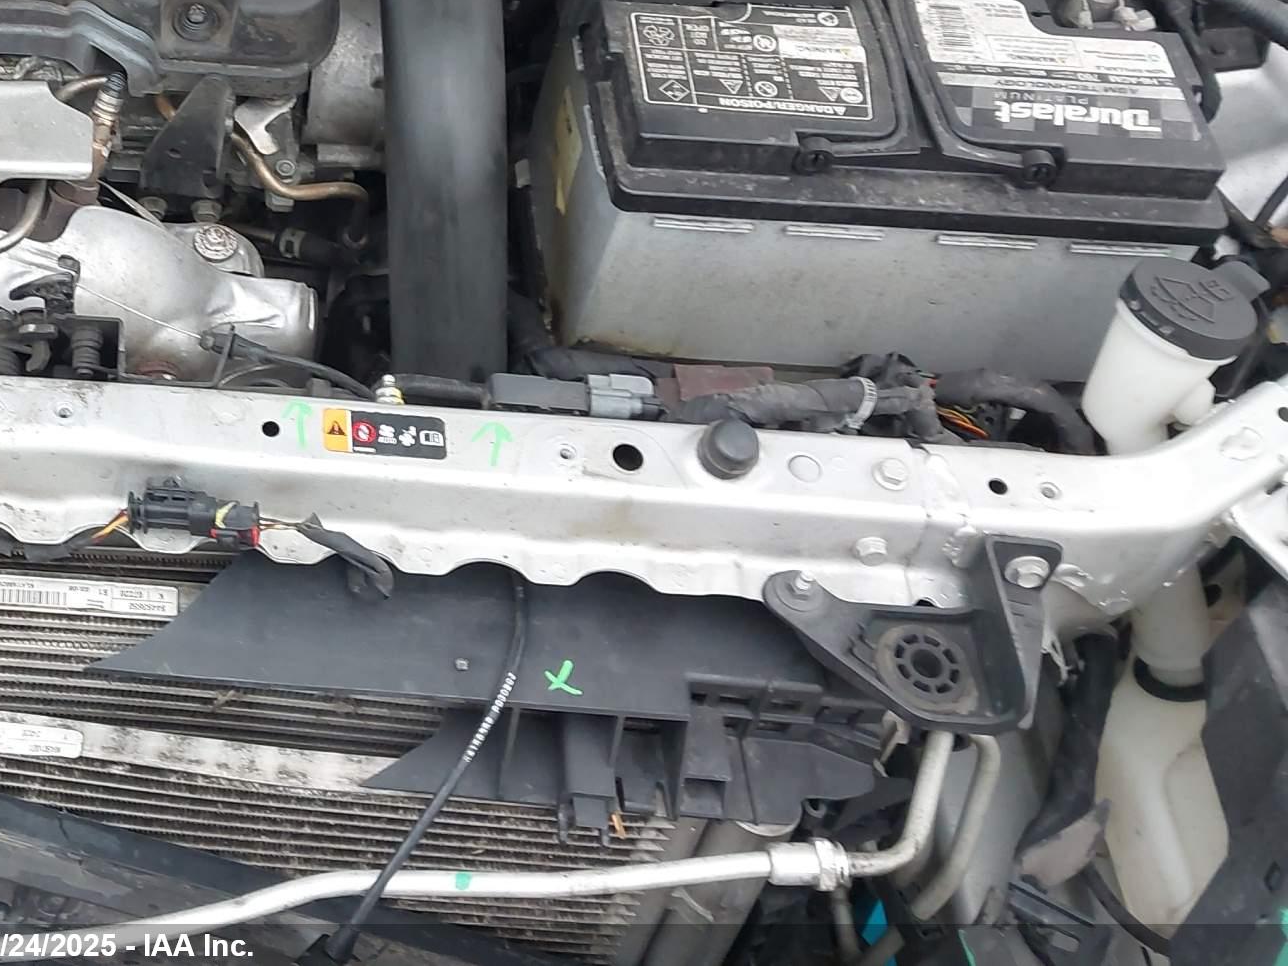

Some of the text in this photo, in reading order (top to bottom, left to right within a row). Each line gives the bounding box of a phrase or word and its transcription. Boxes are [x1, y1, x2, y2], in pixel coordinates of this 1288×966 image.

[993, 79, 1100, 92] TECHNOLOGY
[992, 91, 1089, 105] PLATINUM
[994, 101, 1161, 133] Duralast
